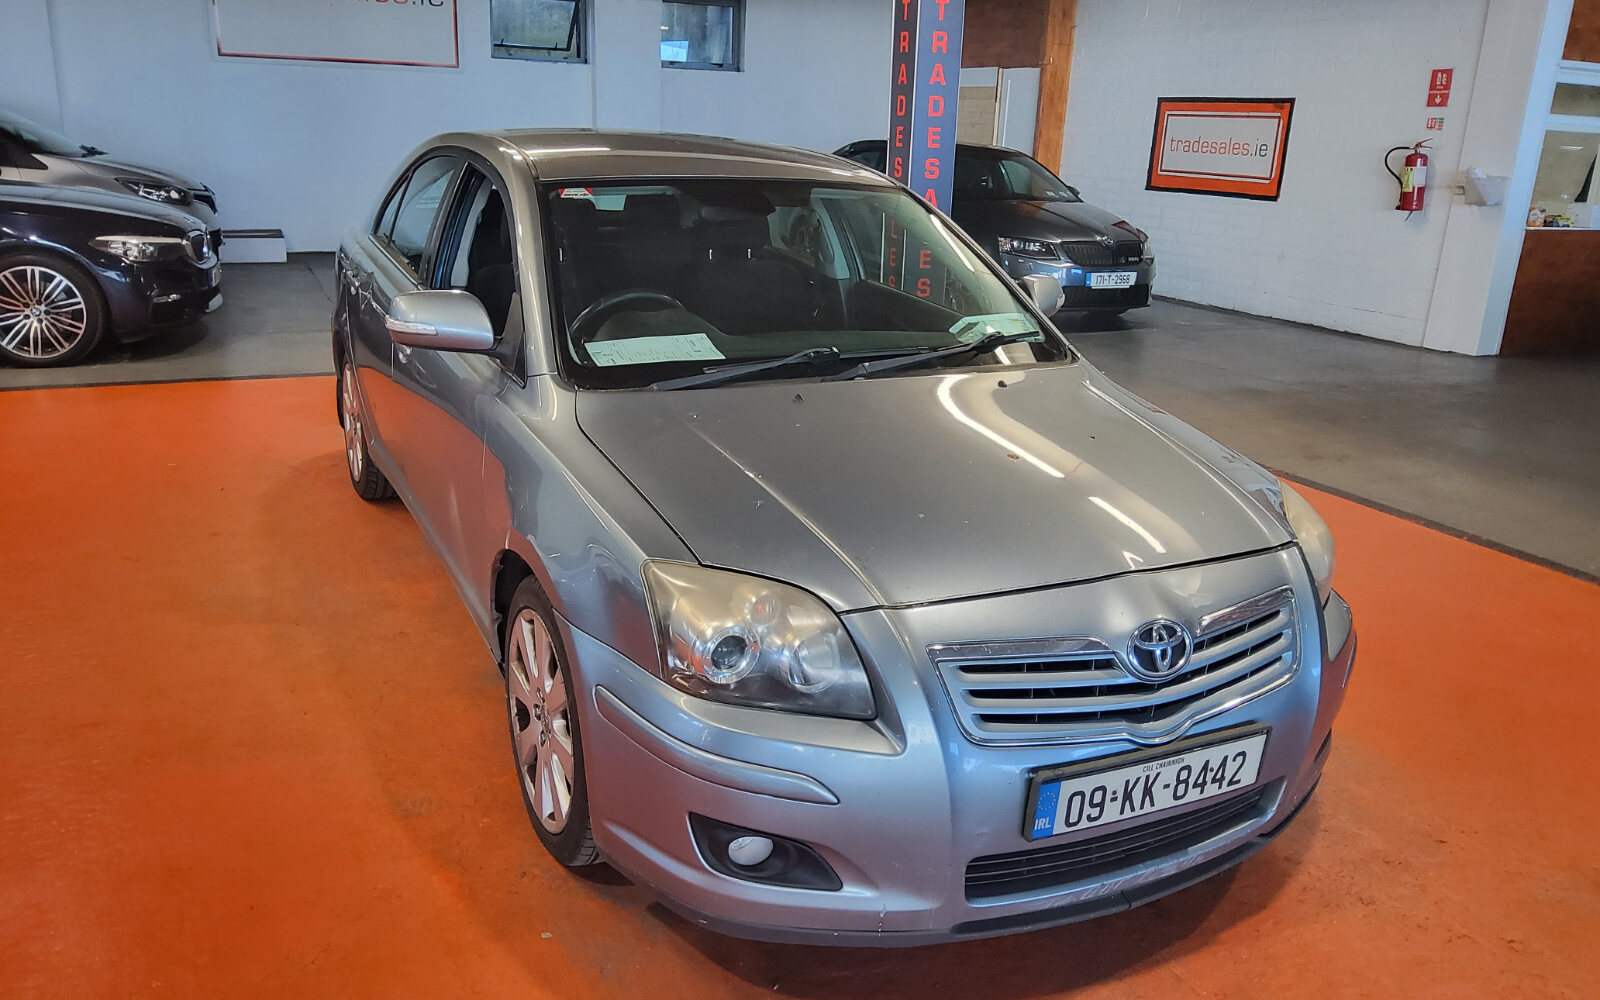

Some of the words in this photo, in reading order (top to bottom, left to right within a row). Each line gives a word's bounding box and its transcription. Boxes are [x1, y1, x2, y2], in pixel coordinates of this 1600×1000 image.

[1170, 136, 1269, 157] tradesales.ie
[1065, 750, 1248, 829] 09-KK-8442
[1034, 817, 1052, 831] IRL
